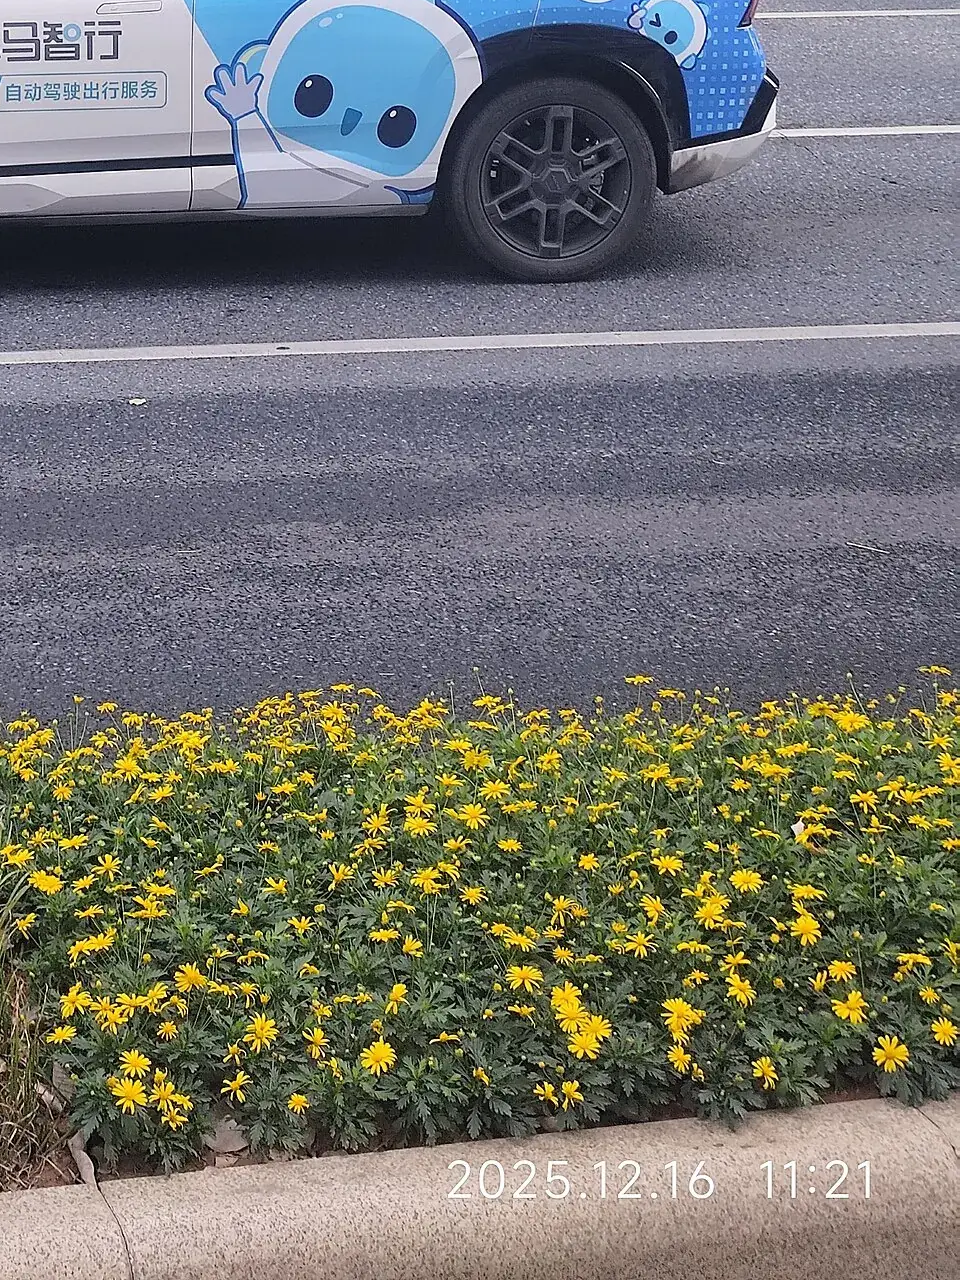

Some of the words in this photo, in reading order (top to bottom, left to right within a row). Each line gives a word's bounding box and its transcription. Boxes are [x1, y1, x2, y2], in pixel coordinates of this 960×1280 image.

[5, 80, 158, 102] 自动驾驶出行服务
